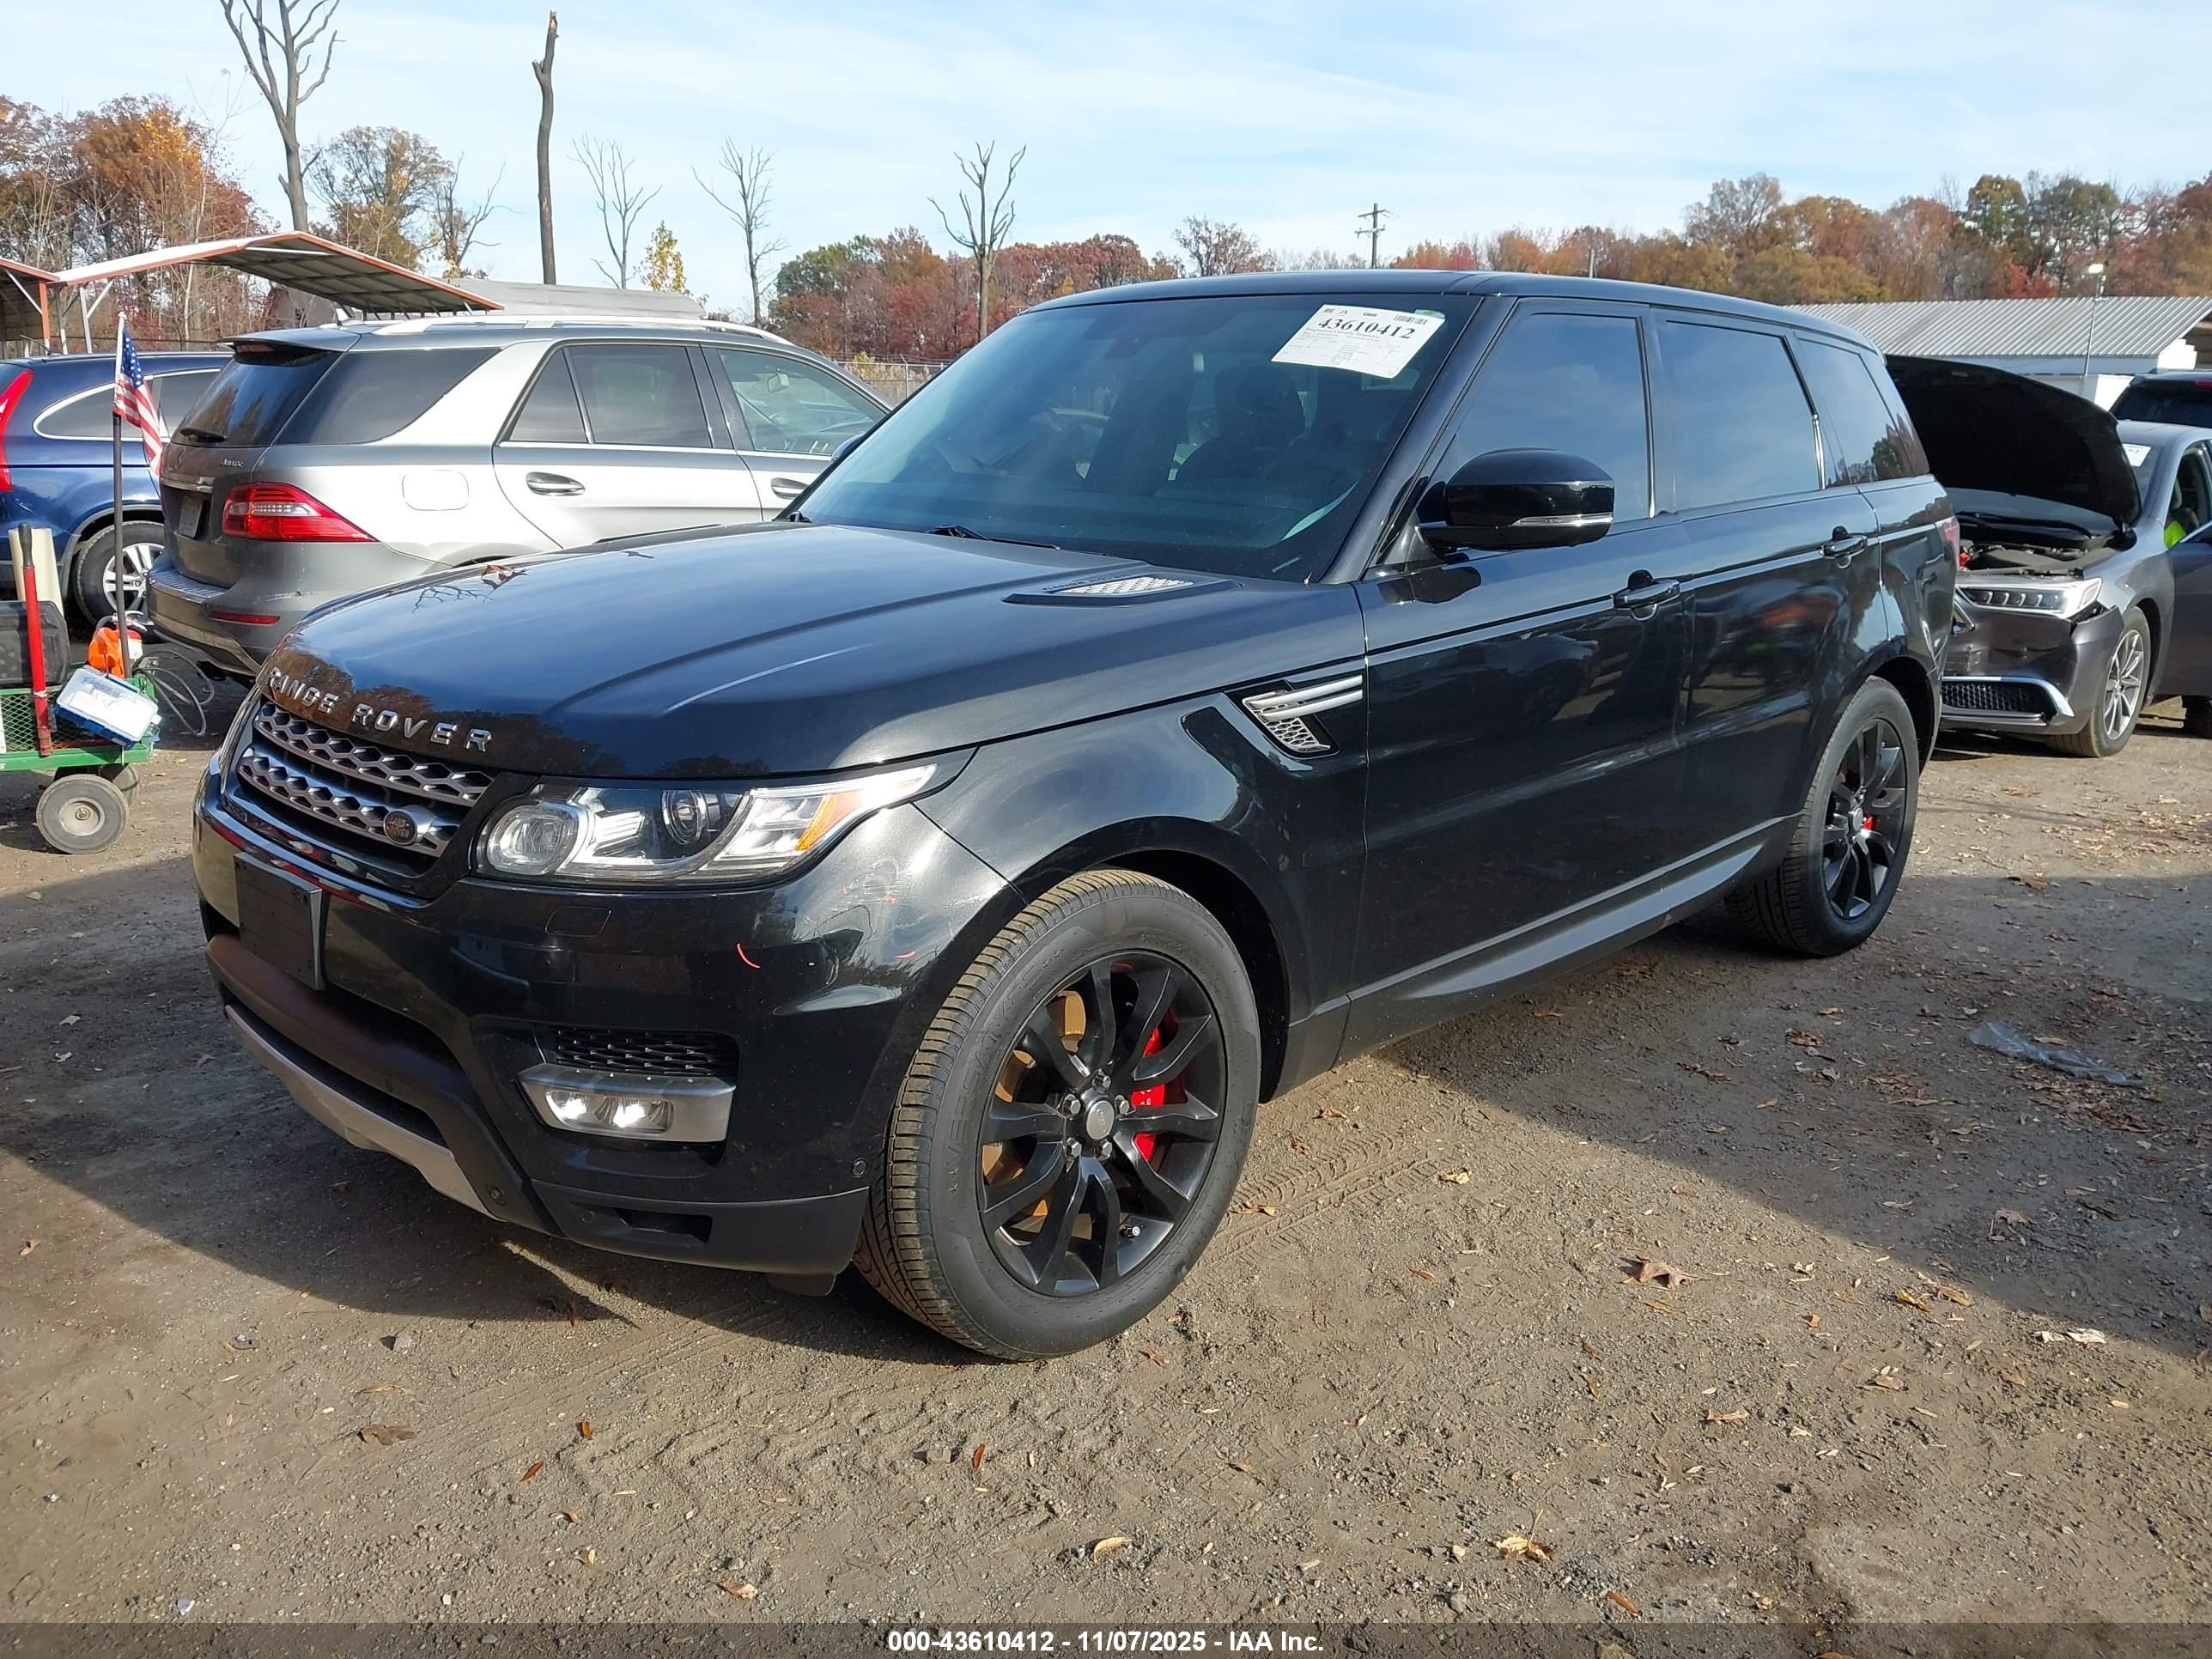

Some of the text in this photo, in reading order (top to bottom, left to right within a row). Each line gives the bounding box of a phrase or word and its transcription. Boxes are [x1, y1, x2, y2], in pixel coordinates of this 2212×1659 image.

[1318, 318, 1416, 339] 43610412
[267, 666, 493, 753] RANGE ROVER
